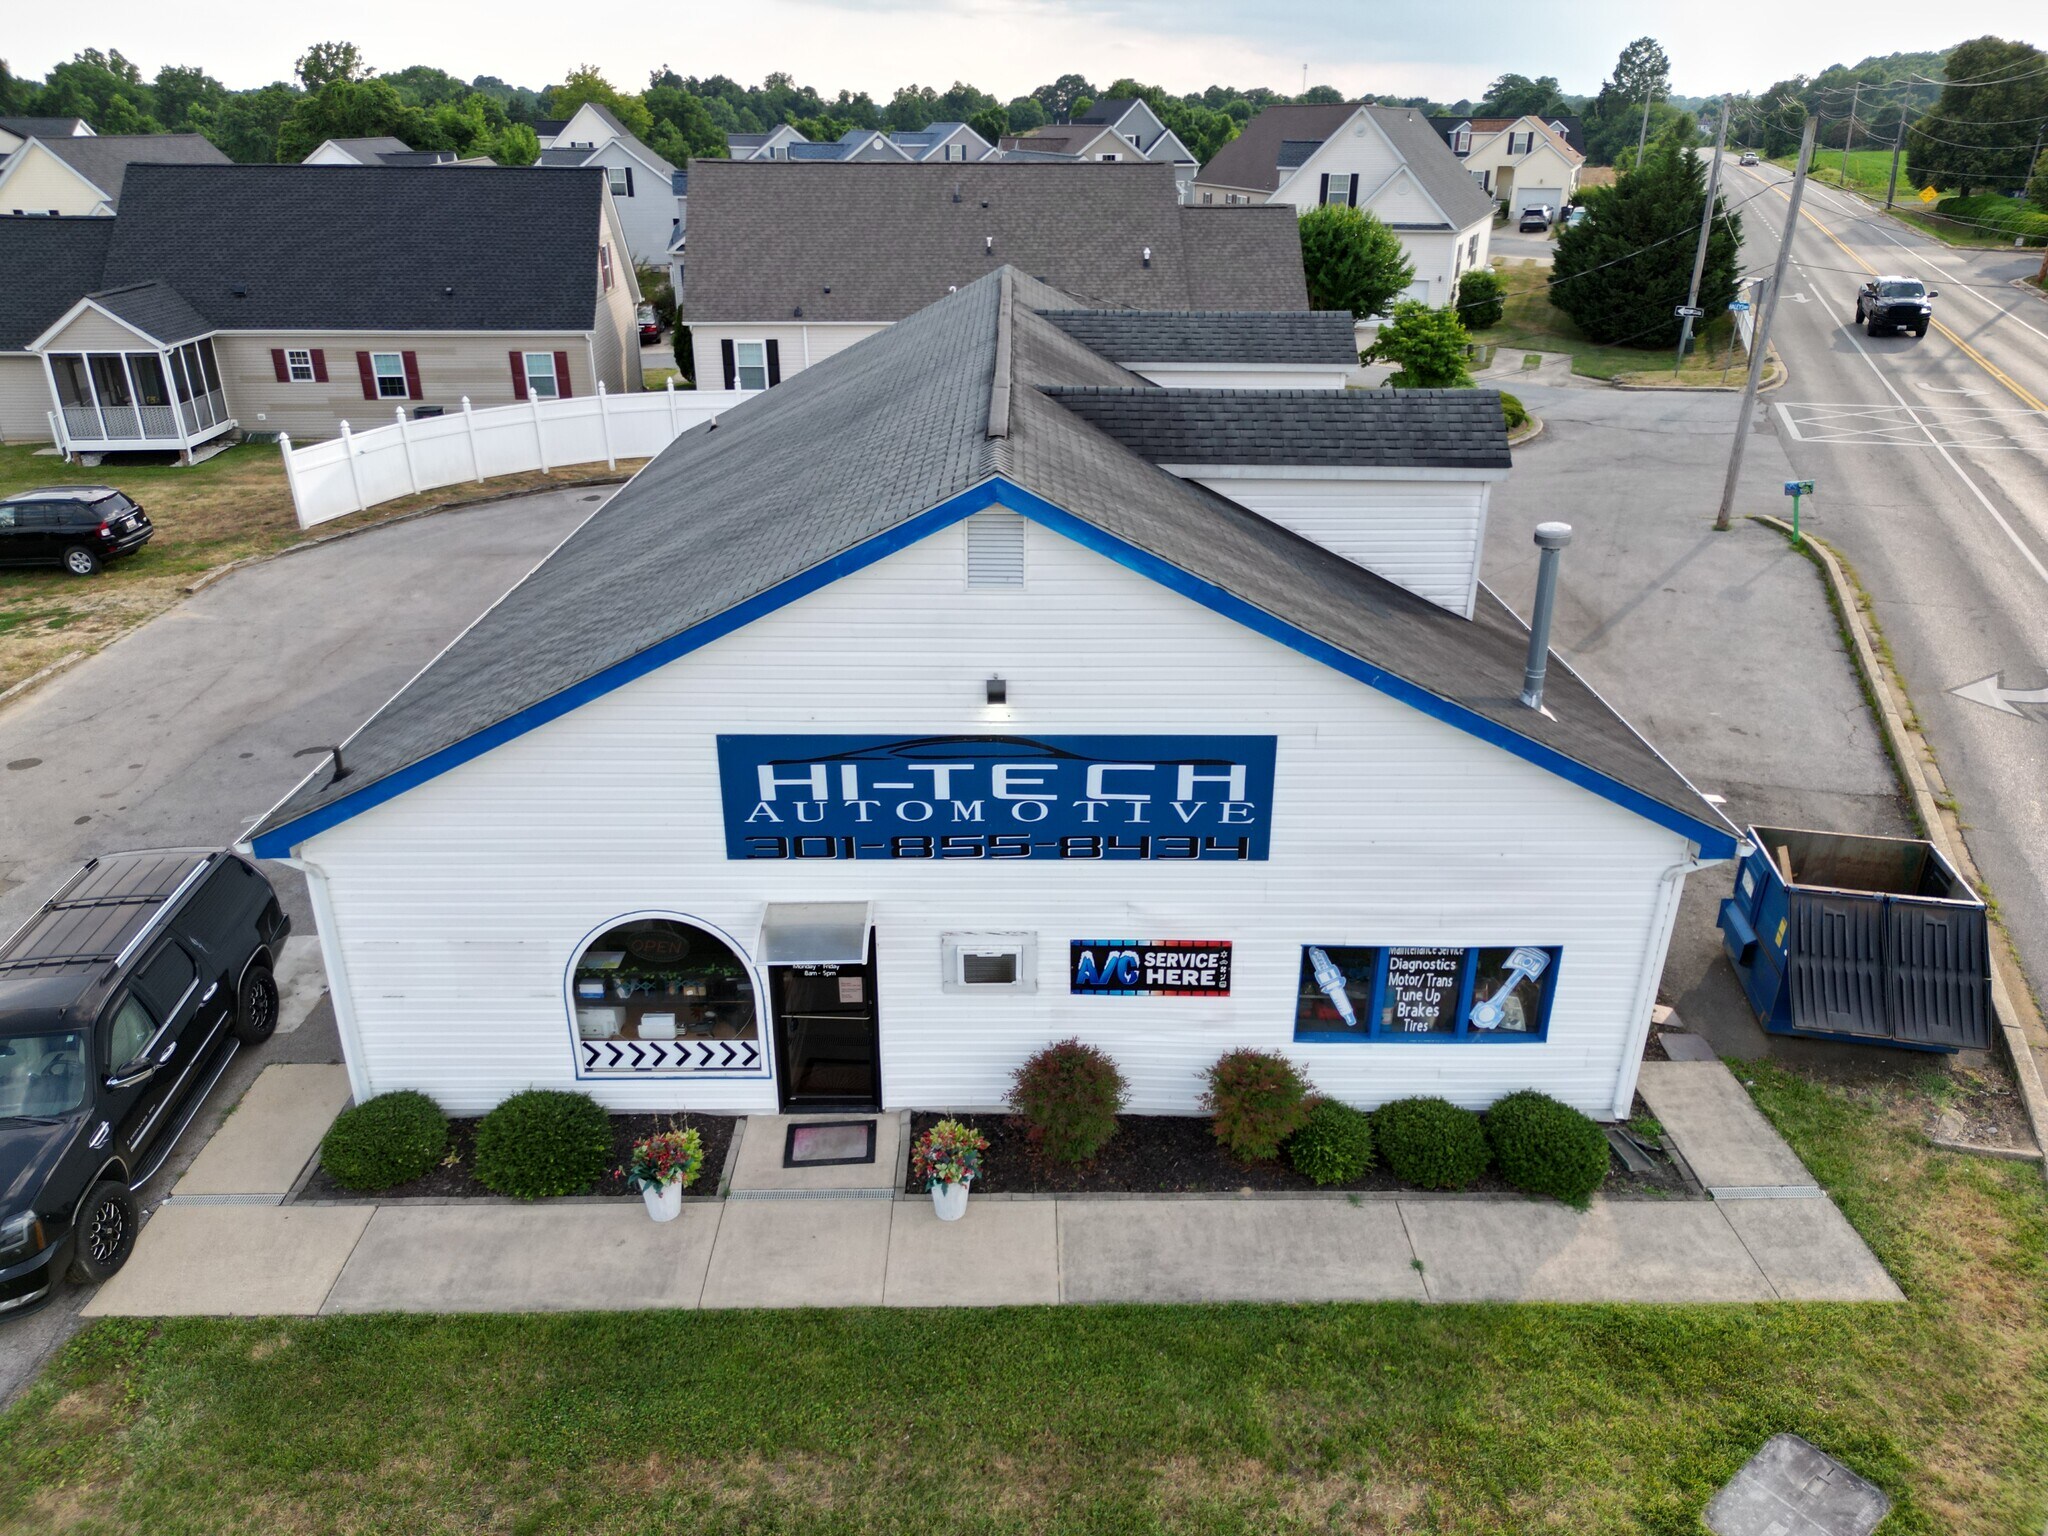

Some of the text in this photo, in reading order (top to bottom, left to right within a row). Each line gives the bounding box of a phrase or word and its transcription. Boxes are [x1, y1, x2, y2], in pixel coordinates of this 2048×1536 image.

[757, 763, 1247, 801] HI-TECH
[744, 800, 1256, 824] AUTOMOTIVE
[745, 833, 1249, 860] 301-855-8434
[631, 939, 682, 953] OPEN
[1075, 950, 1140, 985] A/C
[1144, 952, 1219, 968] SERVICE
[1389, 957, 1457, 973] Diagnostics
[1146, 969, 1216, 986] HERE
[1388, 972, 1453, 988] Motor/ Trans
[1395, 987, 1441, 1005] Tune Up
[1397, 1002, 1440, 1018] Brakes
[1403, 1018, 1428, 1032] Tires
